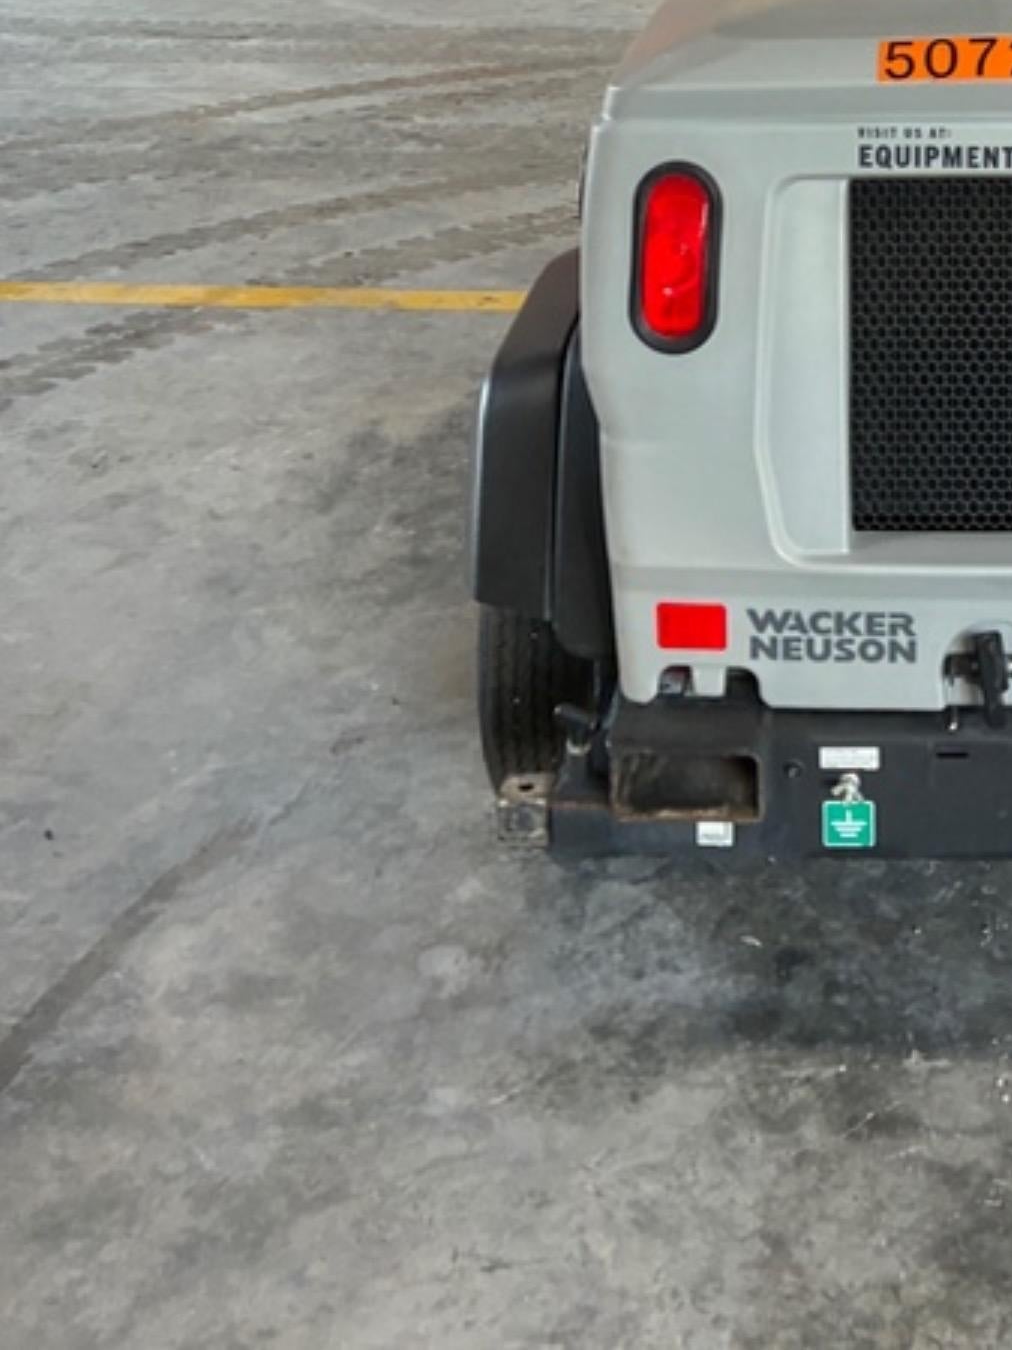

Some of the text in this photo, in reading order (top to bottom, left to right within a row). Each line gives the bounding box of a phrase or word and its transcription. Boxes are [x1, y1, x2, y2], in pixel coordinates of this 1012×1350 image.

[857, 127, 897, 138] VISIT
[903, 128, 922, 138] US
[747, 608, 916, 637] WACKER
[749, 635, 918, 664] NEUSON
